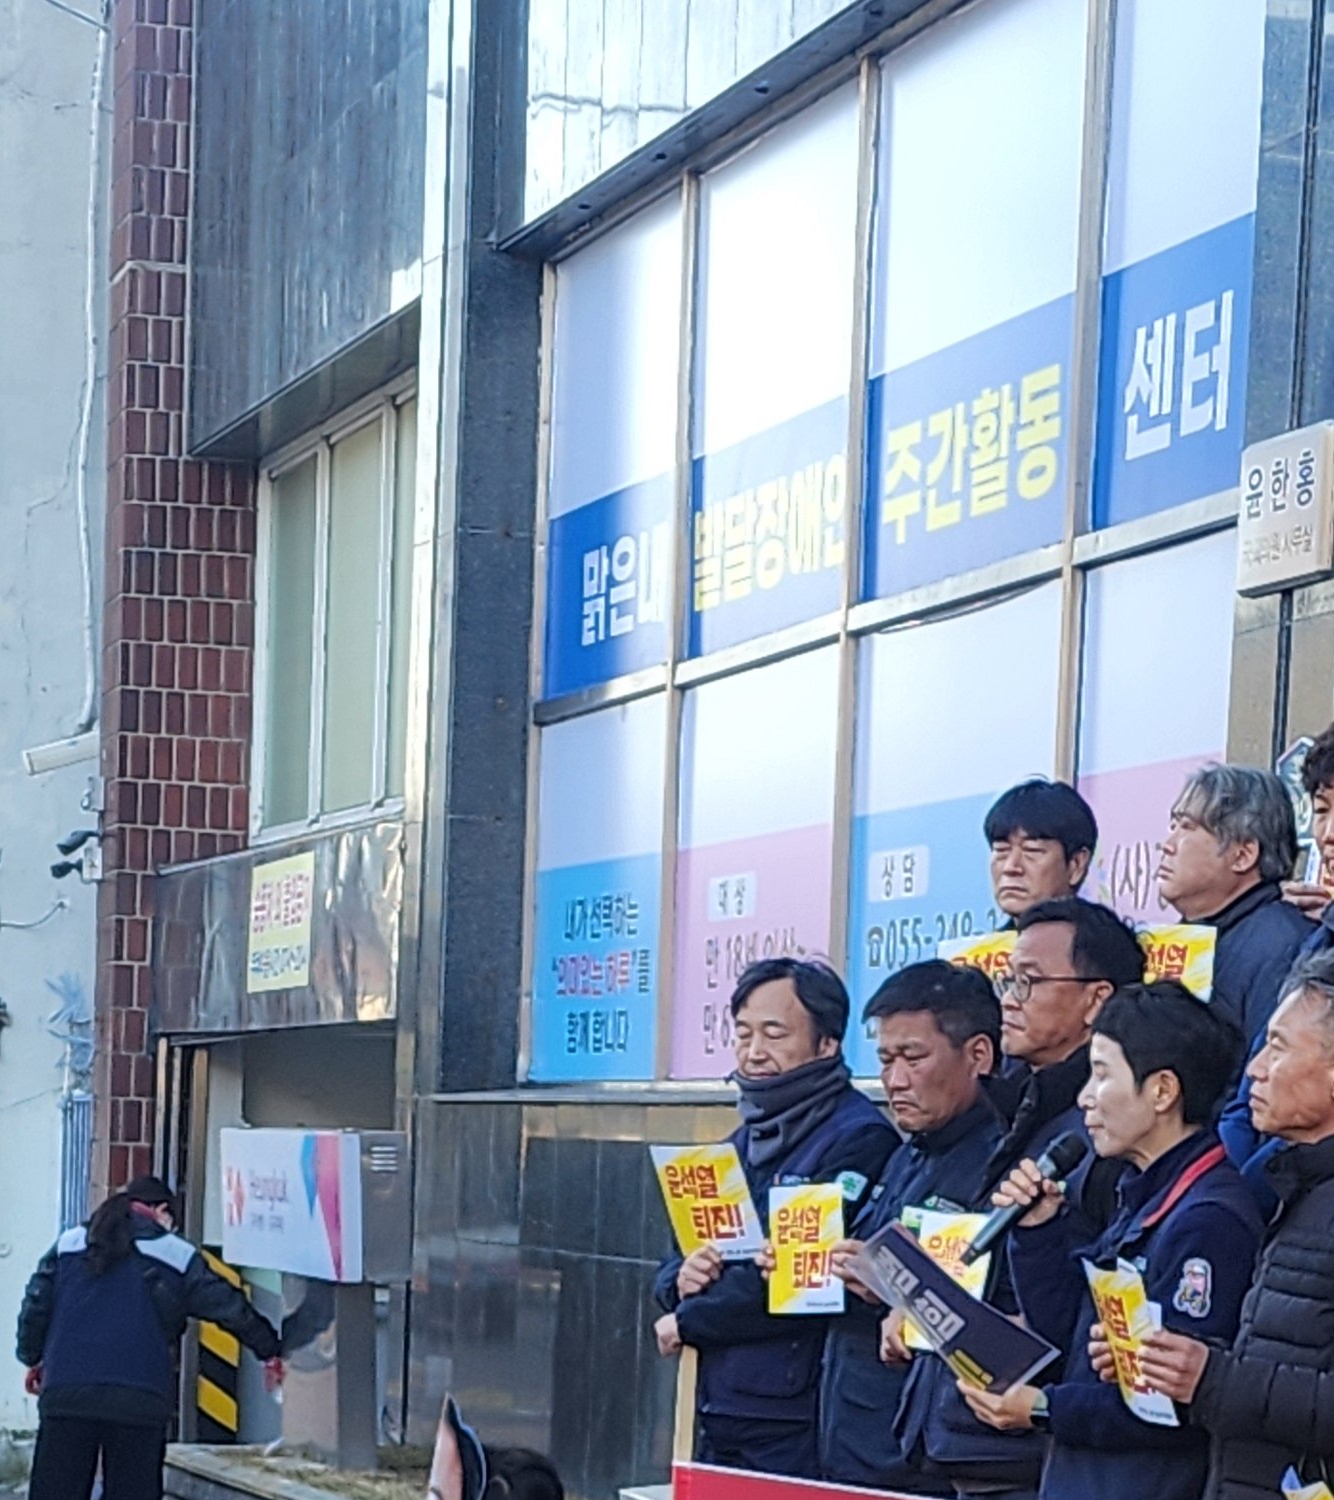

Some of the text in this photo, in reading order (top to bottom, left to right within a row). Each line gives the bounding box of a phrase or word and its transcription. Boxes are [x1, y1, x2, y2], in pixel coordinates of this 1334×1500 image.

[881, 363, 1063, 546] 주간활동
[1123, 288, 1235, 462] 센터
[1245, 450, 1316, 520] 윤한홍
[882, 854, 915, 898] 상담
[1144, 942, 1189, 982] 석열
[665, 1164, 720, 1200] 윤석열
[691, 1203, 747, 1240] 퇴진!
[777, 1205, 822, 1246] 윤석열
[792, 1249, 834, 1290] 퇴진!
